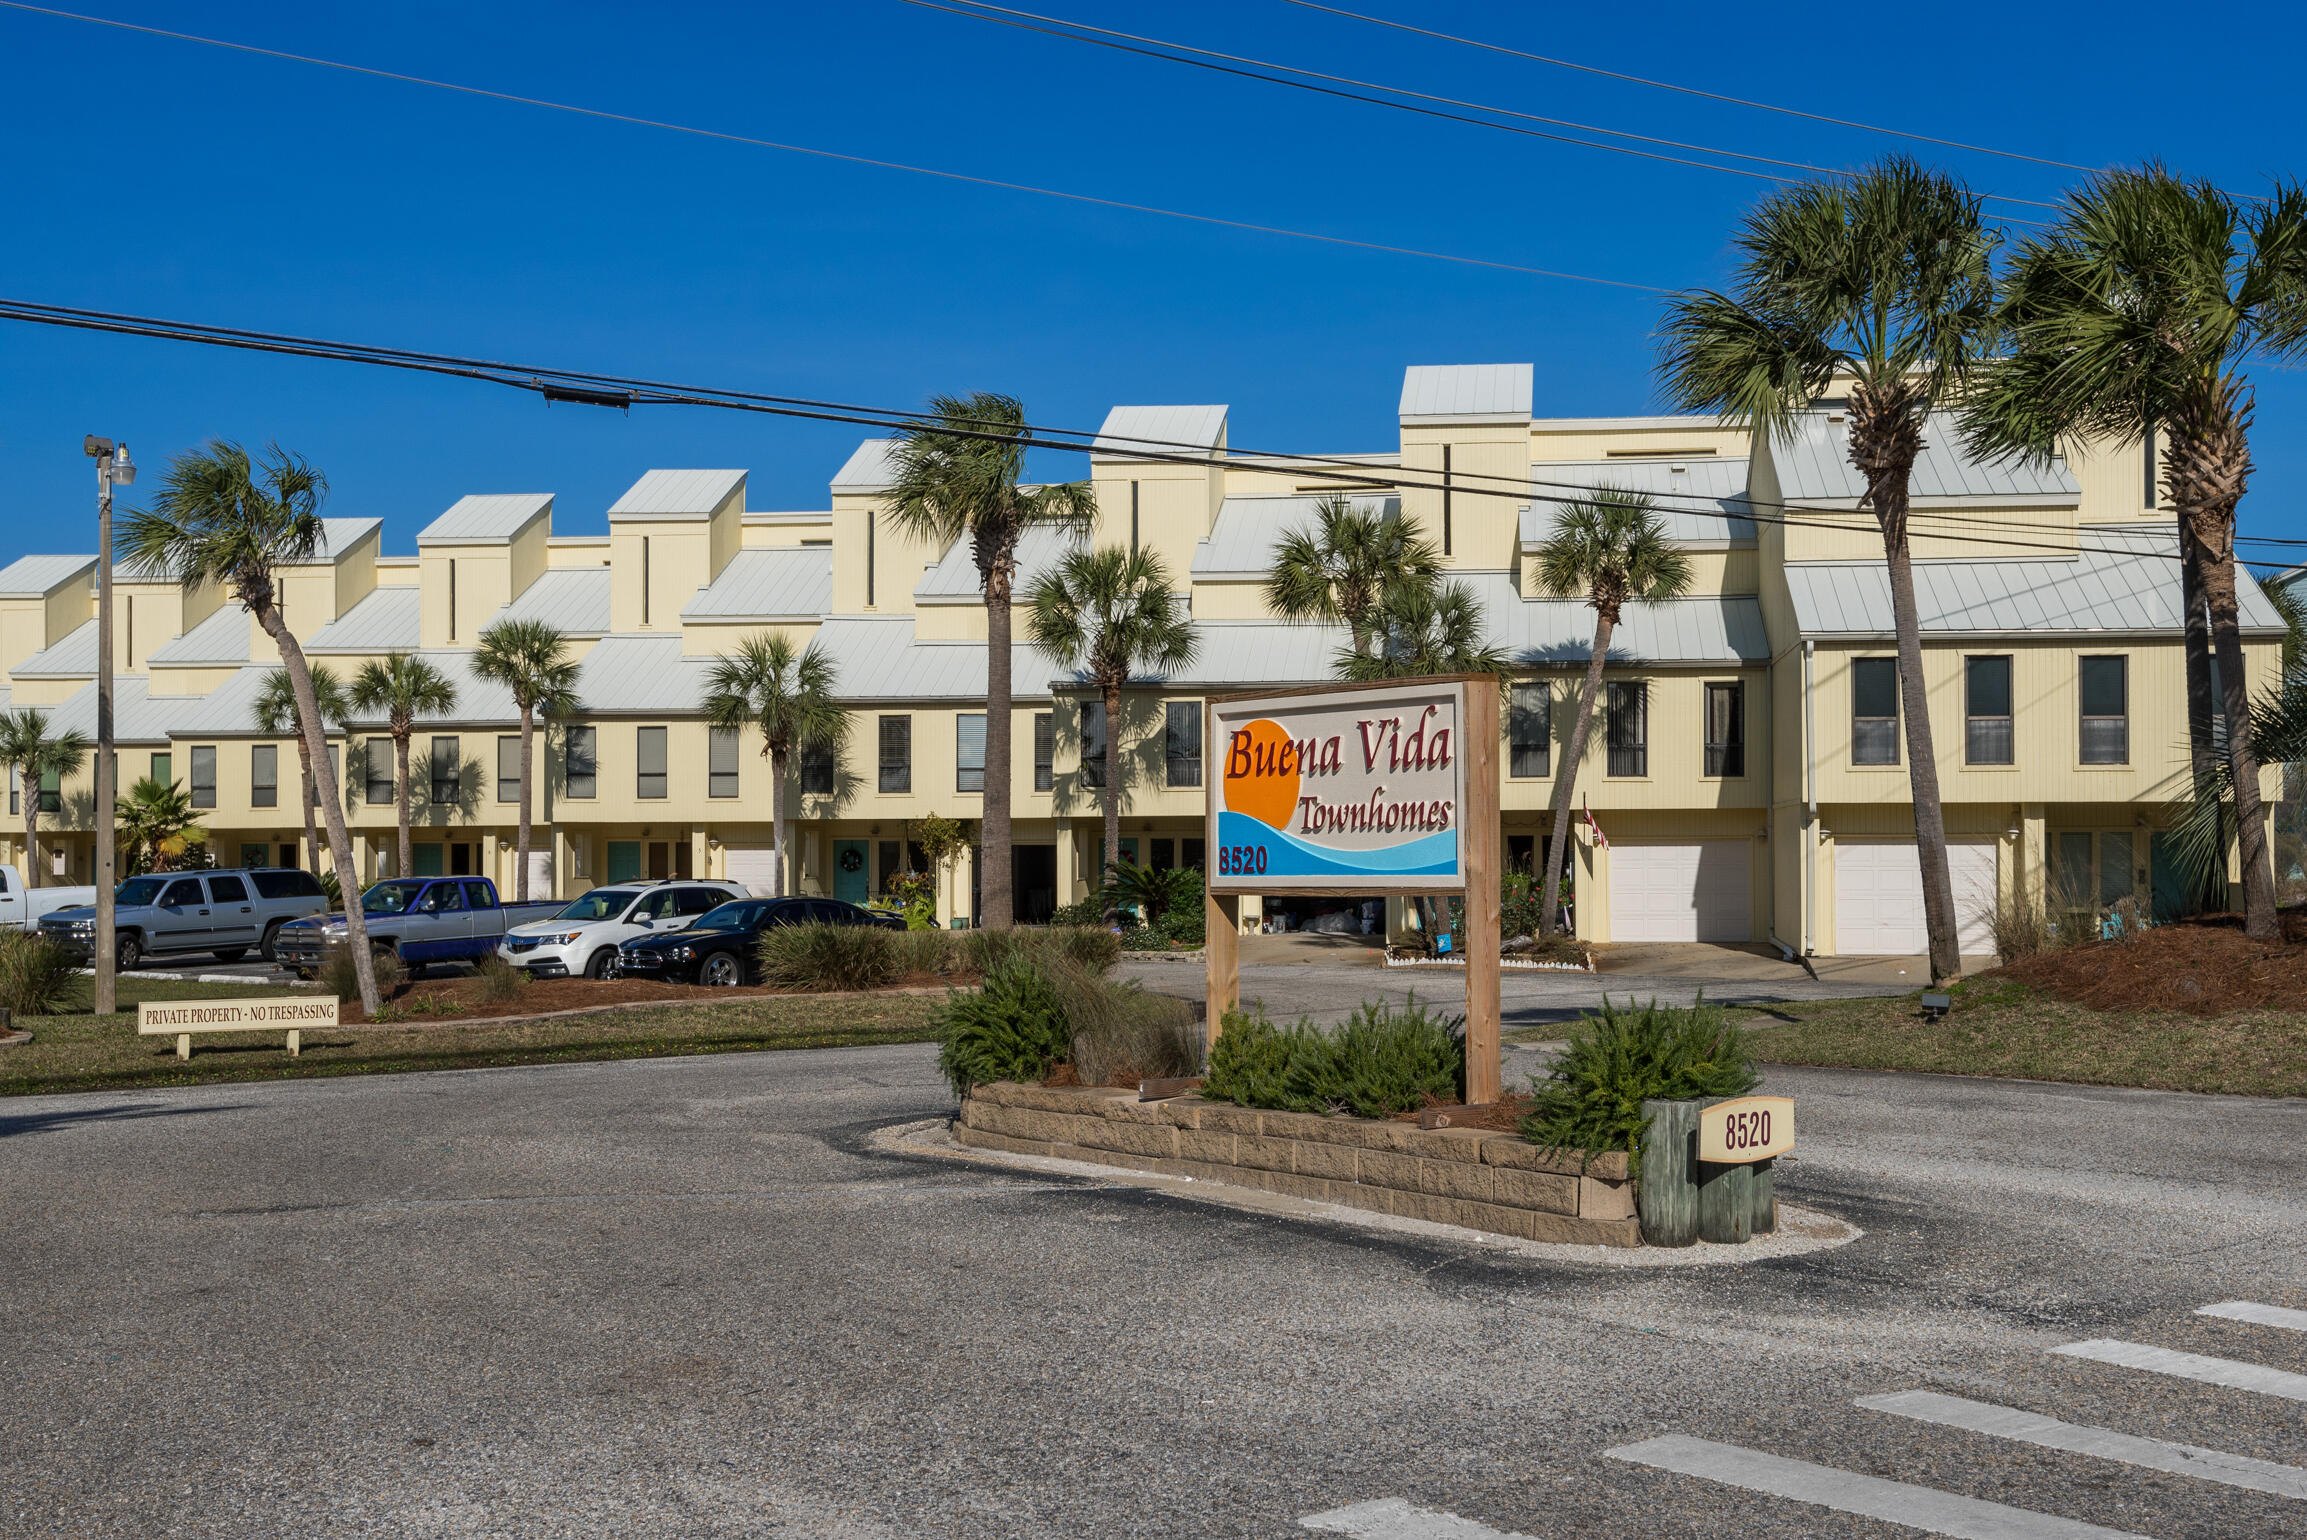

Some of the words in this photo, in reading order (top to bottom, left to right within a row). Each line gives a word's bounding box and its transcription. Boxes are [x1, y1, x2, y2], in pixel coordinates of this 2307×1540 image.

[1227, 729, 1343, 779] Buena
[1357, 704, 1452, 771] Vida
[1299, 786, 1452, 832] Townhomes
[1219, 845, 1268, 873] 8520
[146, 1009, 189, 1024] PRIVATE
[191, 1007, 243, 1023] PROPERTY
[250, 1006, 266, 1021] NO
[267, 1004, 334, 1019] TRESPASSING
[1726, 1110, 1771, 1150] 8520
